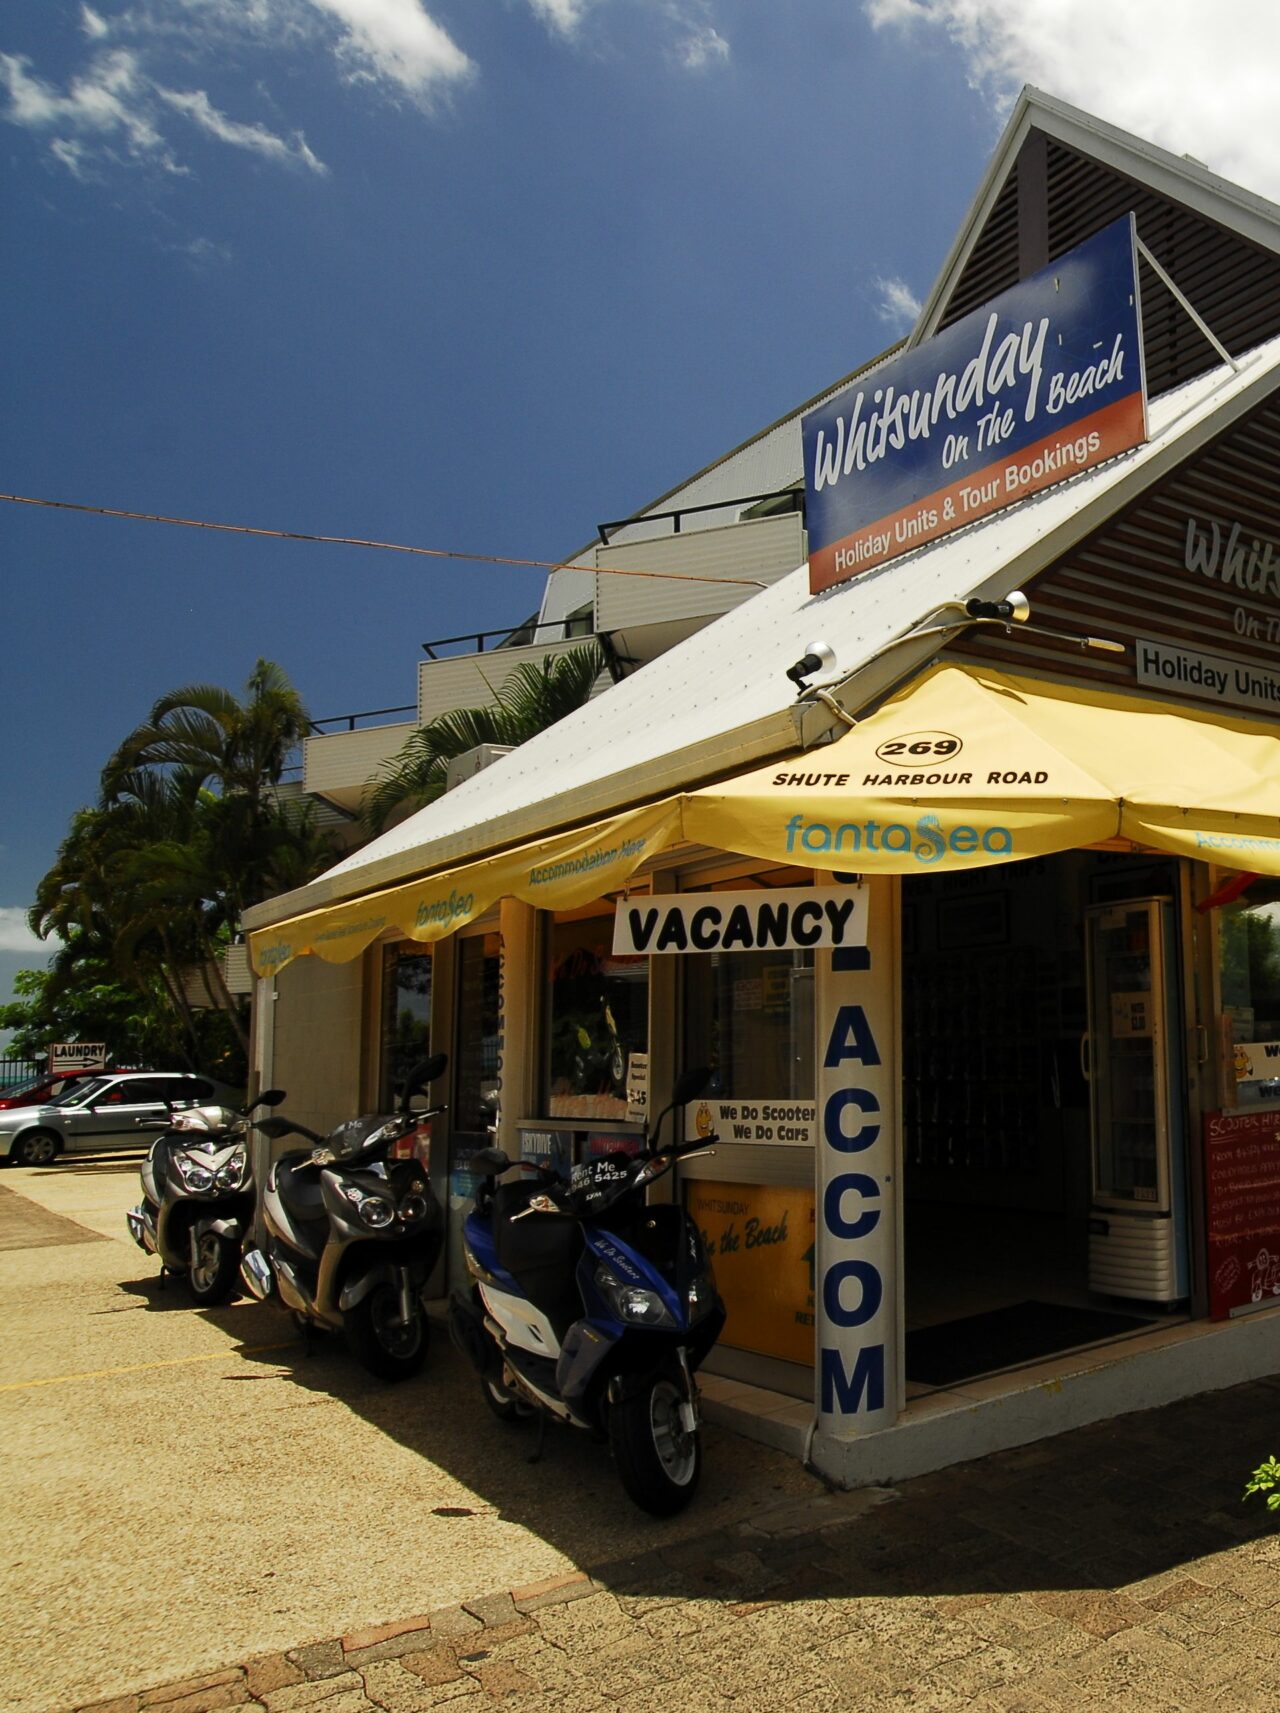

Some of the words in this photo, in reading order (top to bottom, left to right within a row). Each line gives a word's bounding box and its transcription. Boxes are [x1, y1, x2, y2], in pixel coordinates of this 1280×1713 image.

[814, 312, 1050, 492] Whitsunday
[942, 434, 969, 469] On
[976, 401, 1016, 452] The
[1046, 333, 1125, 415] Beach
[834, 528, 891, 573] Holiday
[894, 504, 939, 544] Units
[943, 496, 957, 521] &
[958, 476, 1001, 513] Tour
[1005, 430, 1101, 493] Bookings
[1232, 607, 1260, 639] On
[1143, 648, 1229, 695] Holiday
[880, 739, 959, 757] 269
[772, 773, 851, 787] SHUTE
[862, 772, 973, 786] HARBOUR
[986, 771, 1049, 785] ROAD
[784, 814, 1014, 865] fantaSea
[528, 846, 618, 887] Accommodation
[629, 899, 855, 951] VACANCY
[54, 1045, 105, 1058] LAUNDRY
[719, 1105, 738, 1120] We
[741, 1106, 758, 1120] Do
[1209, 1117, 1260, 1137] SCOOTER
[733, 1125, 752, 1139] We
[755, 1126, 773, 1140] Do
[777, 1126, 809, 1142] Cars
[595, 1170, 628, 1182] 5425
[597, 1161, 616, 1172] Me
[820, 1004, 884, 1415] ACCOM
[720, 1222, 740, 1255] the
[745, 1209, 789, 1249] Beach
